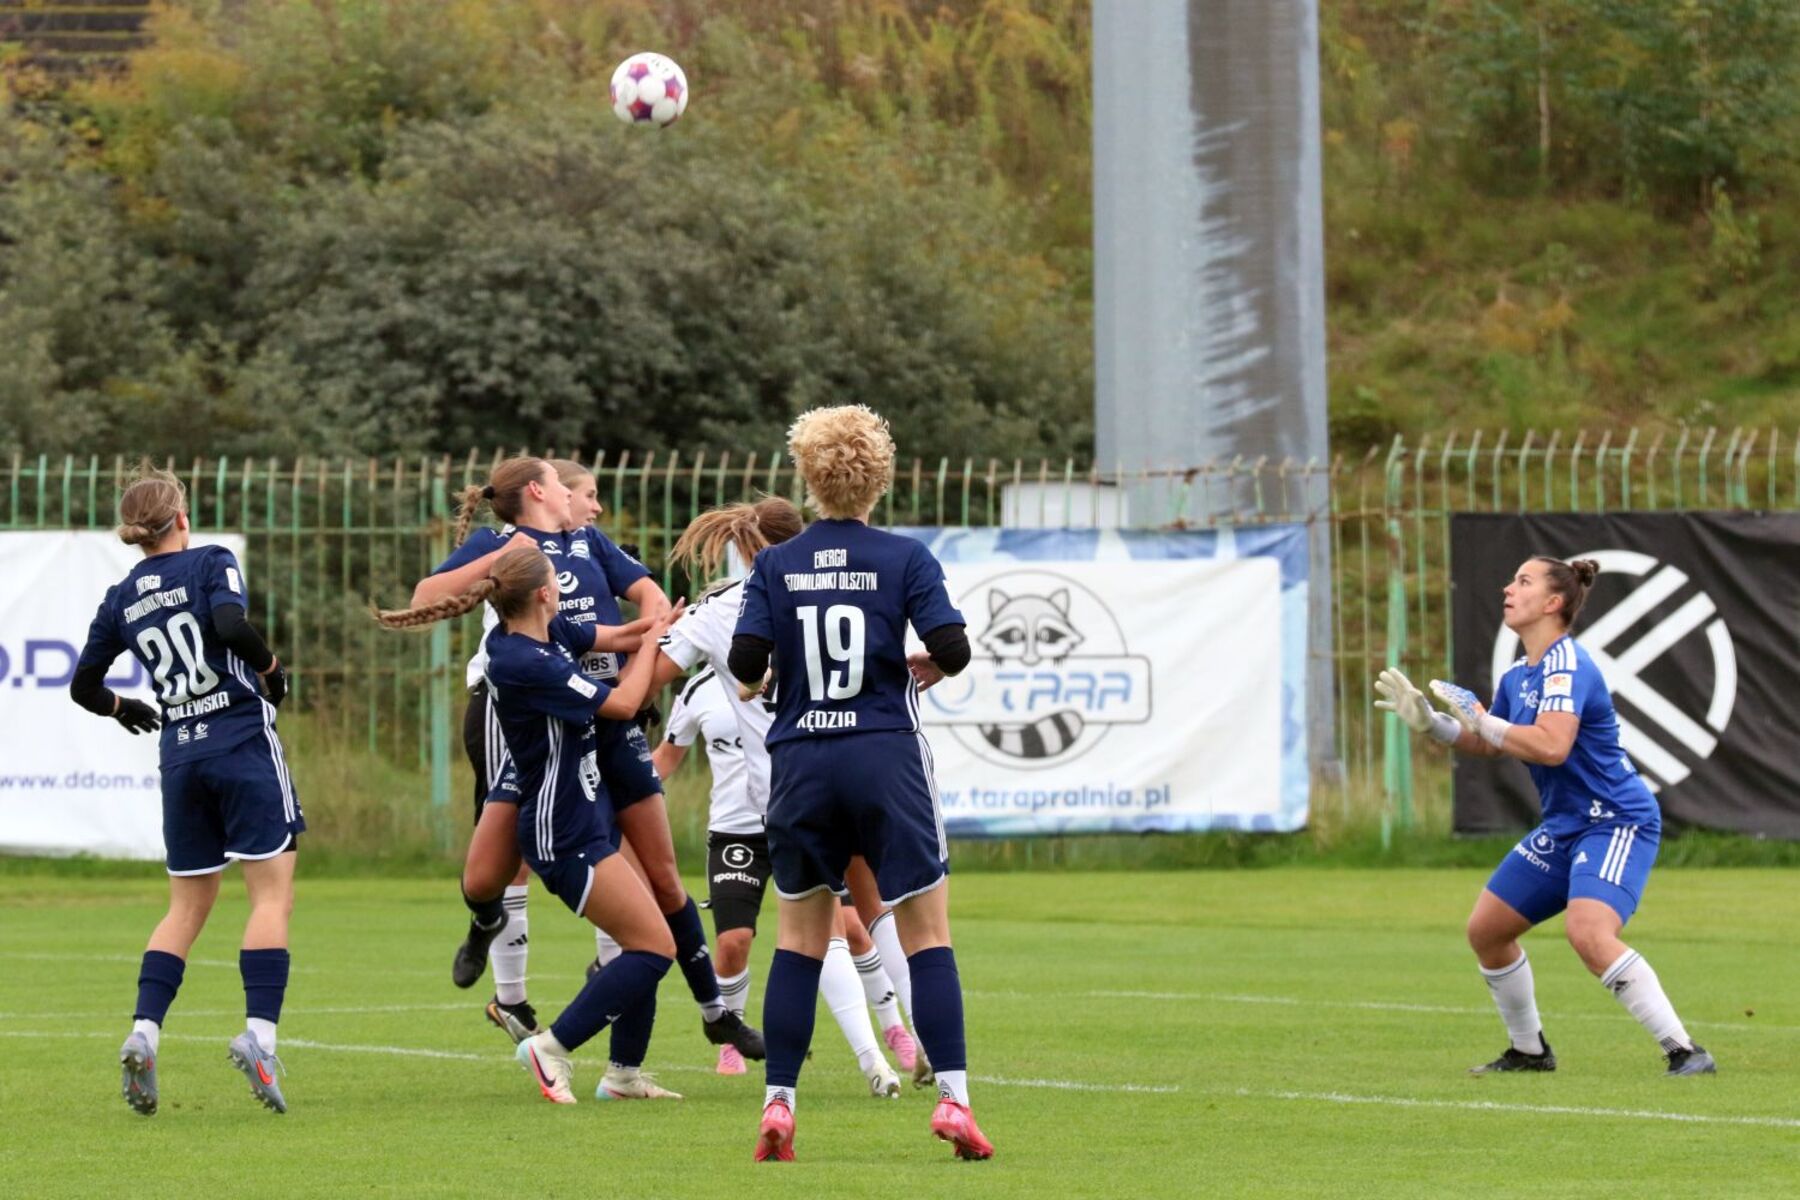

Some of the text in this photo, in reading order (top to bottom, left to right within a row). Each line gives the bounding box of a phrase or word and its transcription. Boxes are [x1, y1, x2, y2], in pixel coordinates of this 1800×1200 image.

[814, 549, 847, 570] ENERGA
[784, 571, 878, 592] STOMILANKI OLSZTYN
[558, 596, 595, 611] nerga
[136, 611, 220, 706] 20
[796, 604, 866, 702] 19
[994, 671, 1133, 712] TARA
[796, 709, 857, 732] KĘDZIA
[0, 771, 161, 790] www.ddom.e
